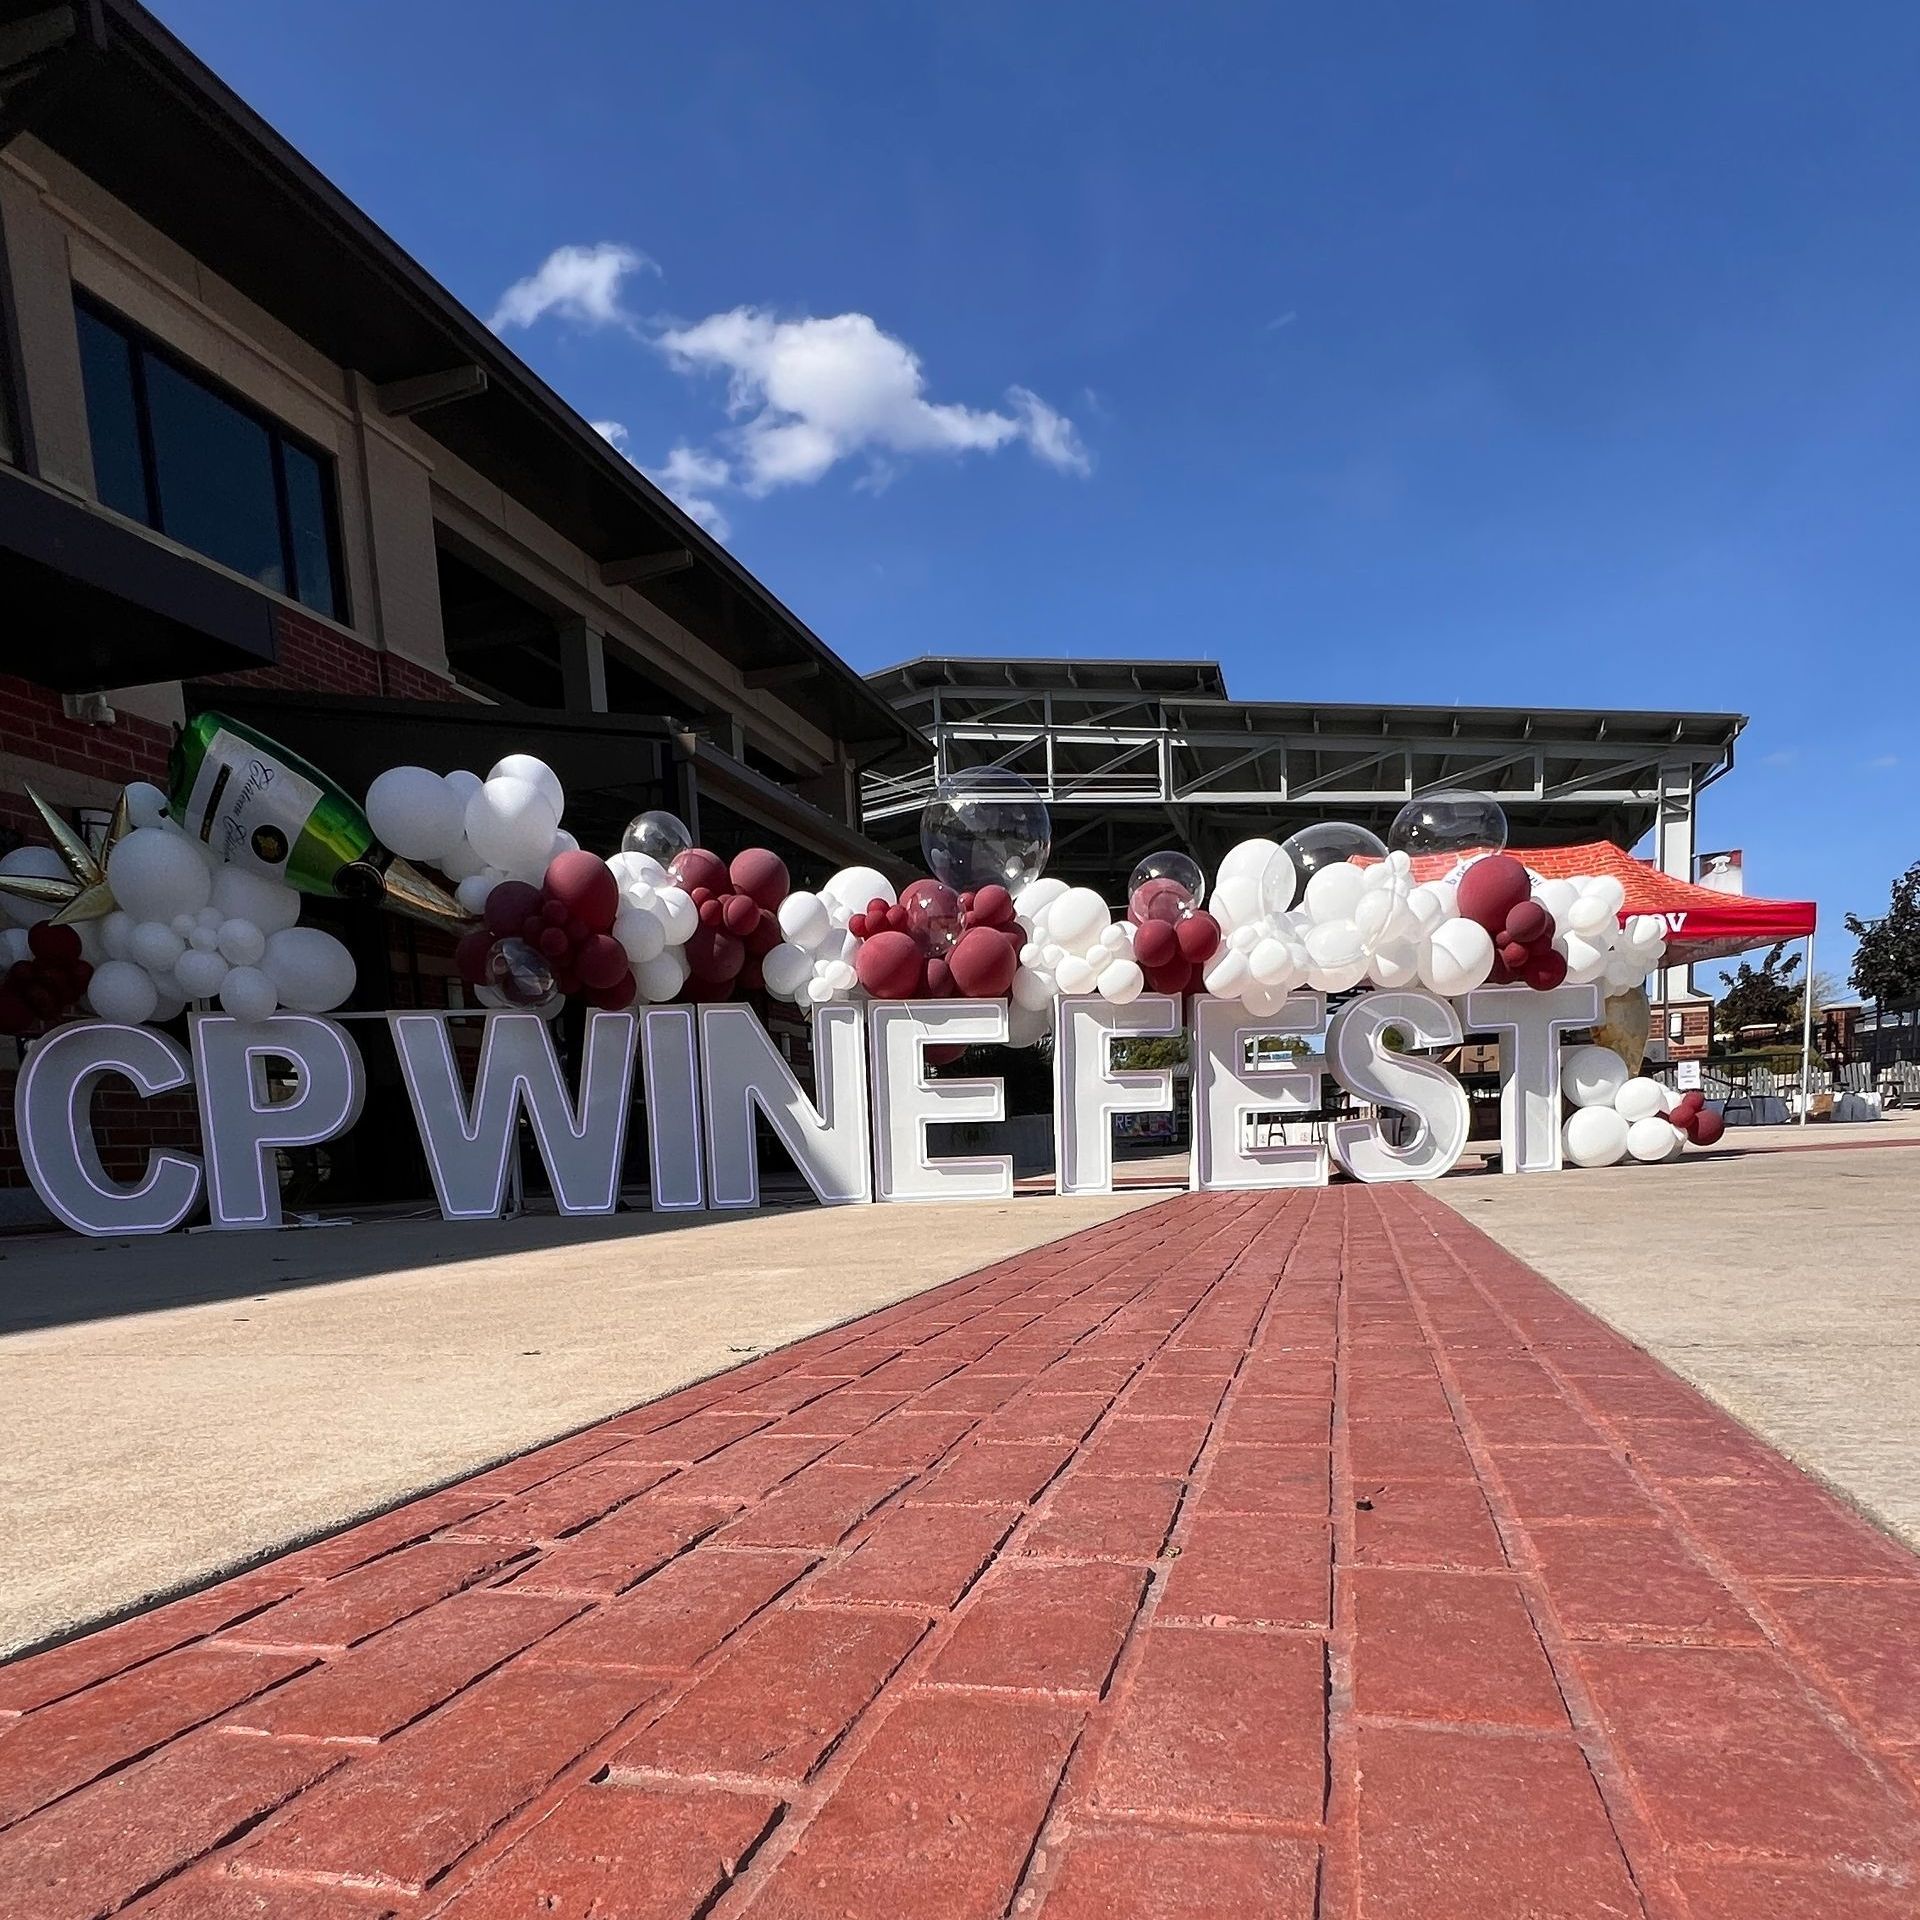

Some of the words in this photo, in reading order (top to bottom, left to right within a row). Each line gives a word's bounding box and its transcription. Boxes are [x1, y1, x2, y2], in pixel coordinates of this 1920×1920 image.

[16, 1010, 366, 1236] CP
[388, 1000, 1014, 1220] WINE
[1053, 983, 1606, 1195] FEST
